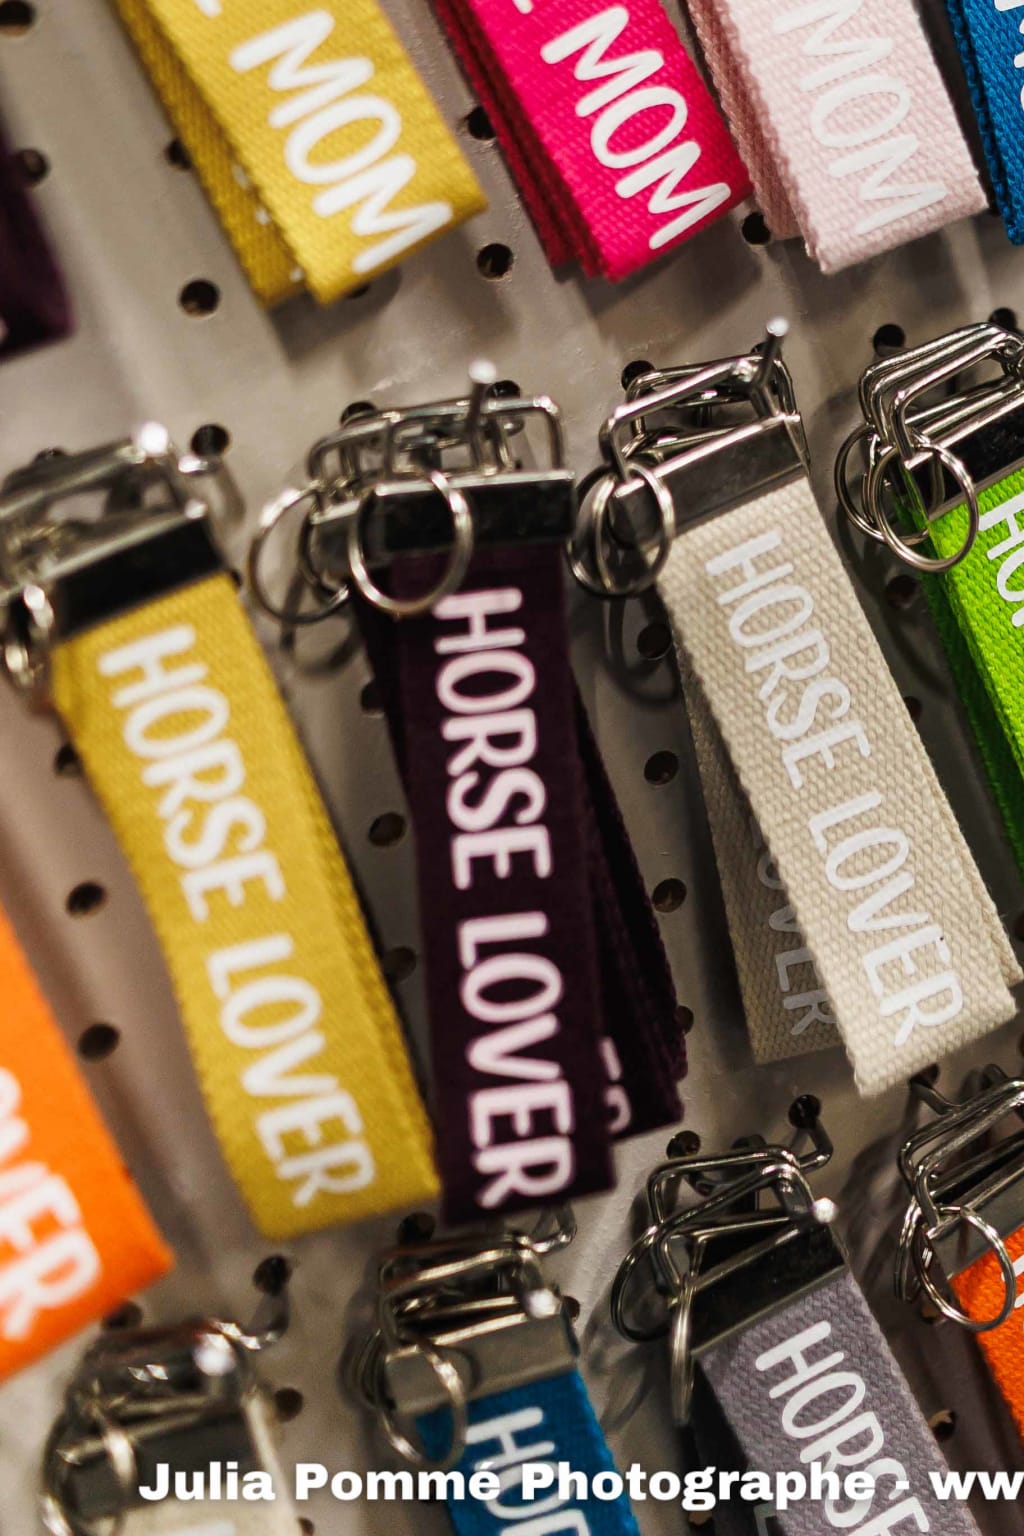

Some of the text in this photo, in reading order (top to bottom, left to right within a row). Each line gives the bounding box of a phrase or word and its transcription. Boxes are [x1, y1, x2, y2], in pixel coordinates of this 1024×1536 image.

[229, 10, 453, 273] MOM
[540, 5, 731, 251] MOM
[97, 623, 377, 1208] HORSE LOVER
[433, 587, 576, 1210] HORSE LOVER
[704, 531, 964, 1046] HORSE LOVER
